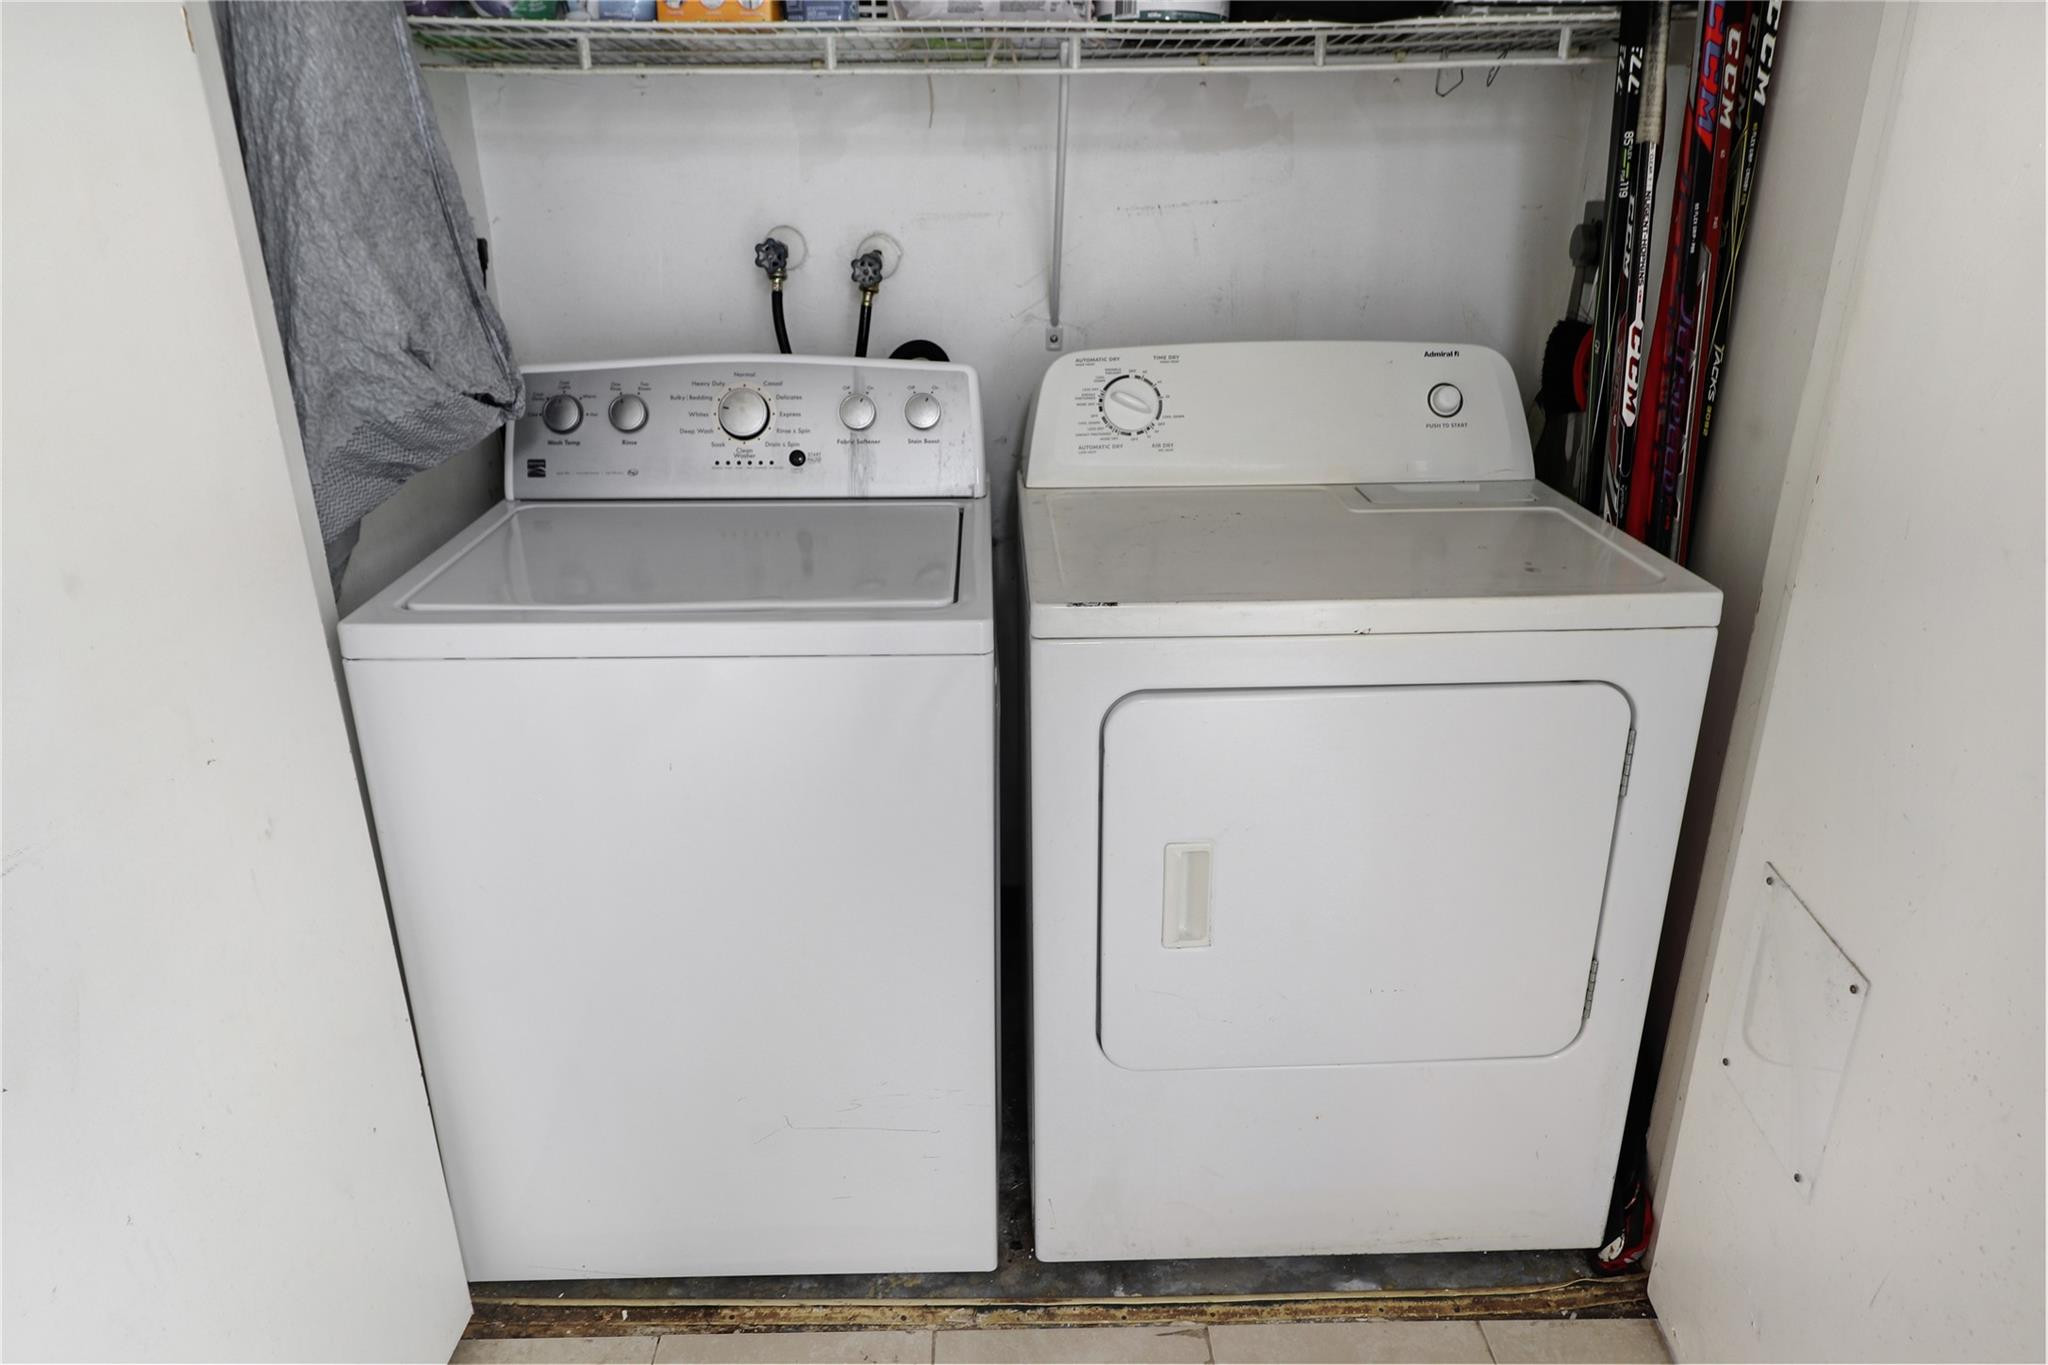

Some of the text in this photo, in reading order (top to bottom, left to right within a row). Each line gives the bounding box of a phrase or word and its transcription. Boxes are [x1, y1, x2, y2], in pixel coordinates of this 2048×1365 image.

[1698, 0, 1725, 132] CCM
[1719, 27, 1741, 128] CCM
[1754, 0, 1782, 107] CCM
[1626, 325, 1643, 415] CCM
[1707, 343, 1725, 402] TACKS
[565, 439, 581, 447] Temp
